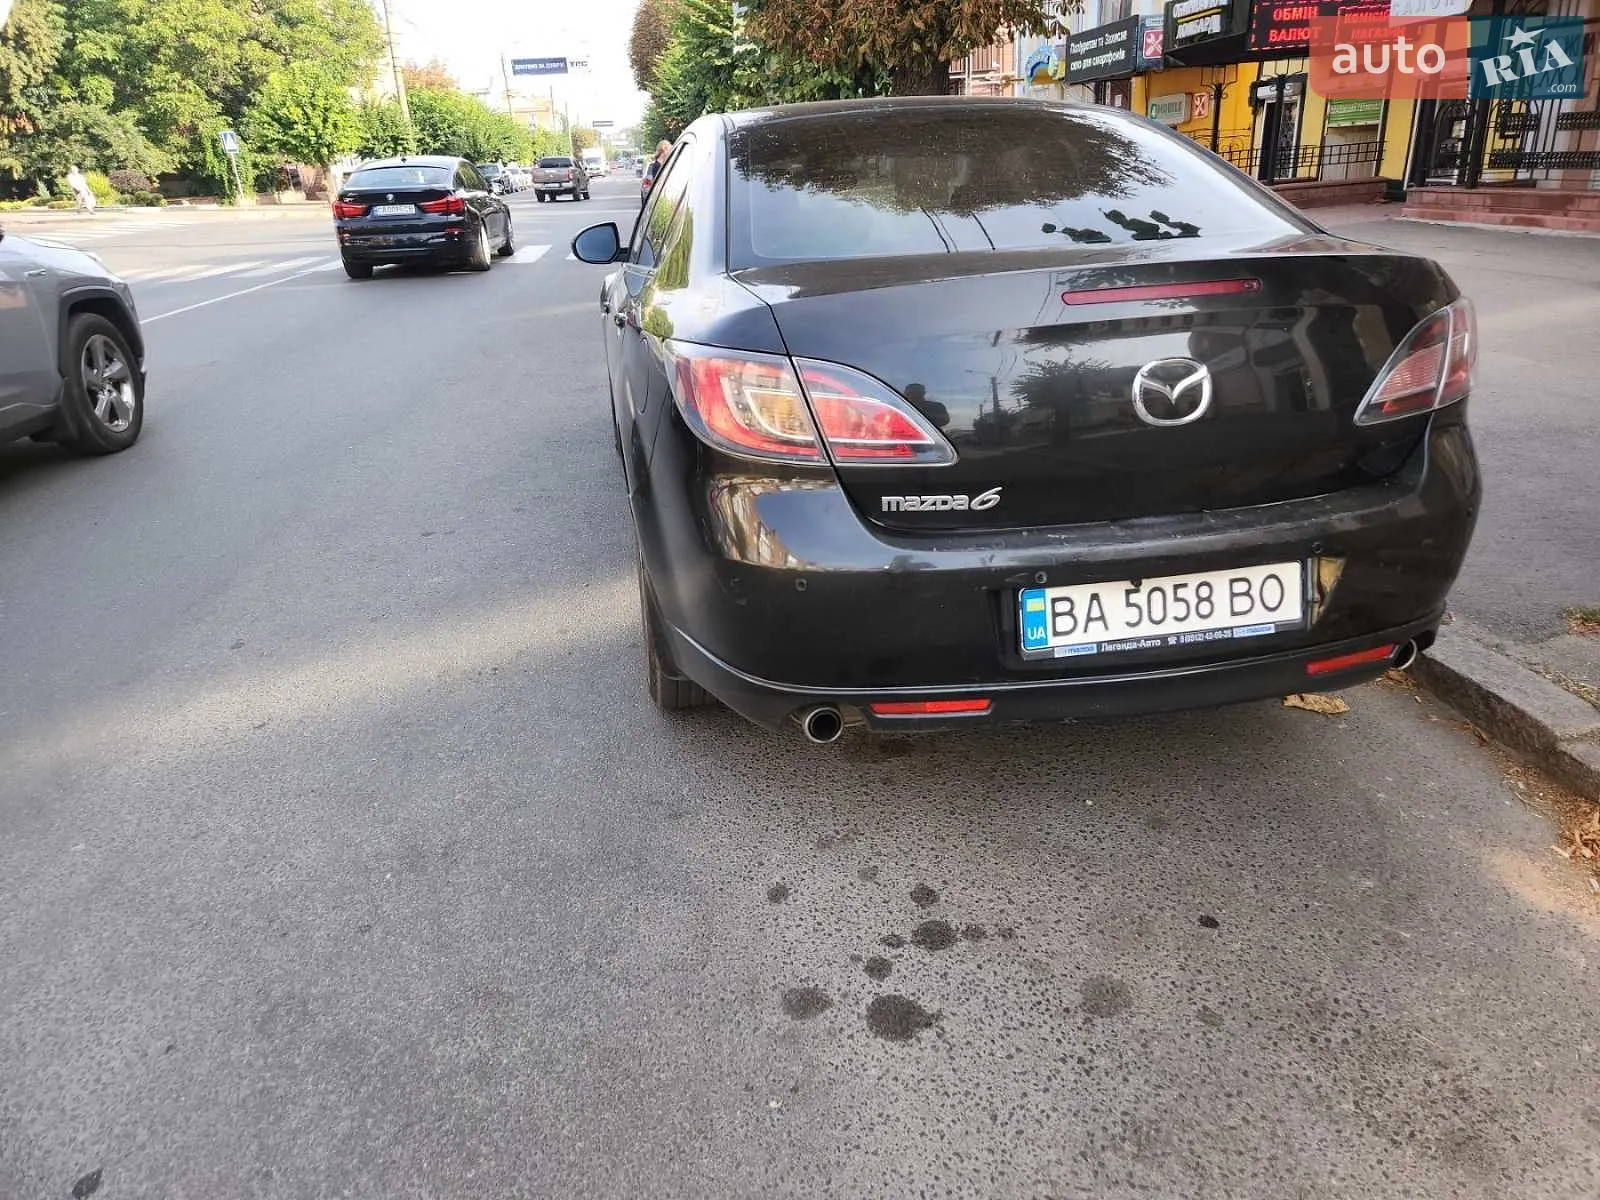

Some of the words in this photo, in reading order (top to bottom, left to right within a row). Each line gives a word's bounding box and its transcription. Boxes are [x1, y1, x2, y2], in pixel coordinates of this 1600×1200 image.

[1273, 7, 1318, 21] ОБМІН
[1269, 26, 1322, 42] ВАЛЮТ
[1051, 591, 1109, 637] BA
[1124, 581, 1214, 628] 5058
[1229, 573, 1284, 617] BO
[1028, 626, 1046, 640] UA
[1101, 639, 1161, 652] Легенда-Авто
